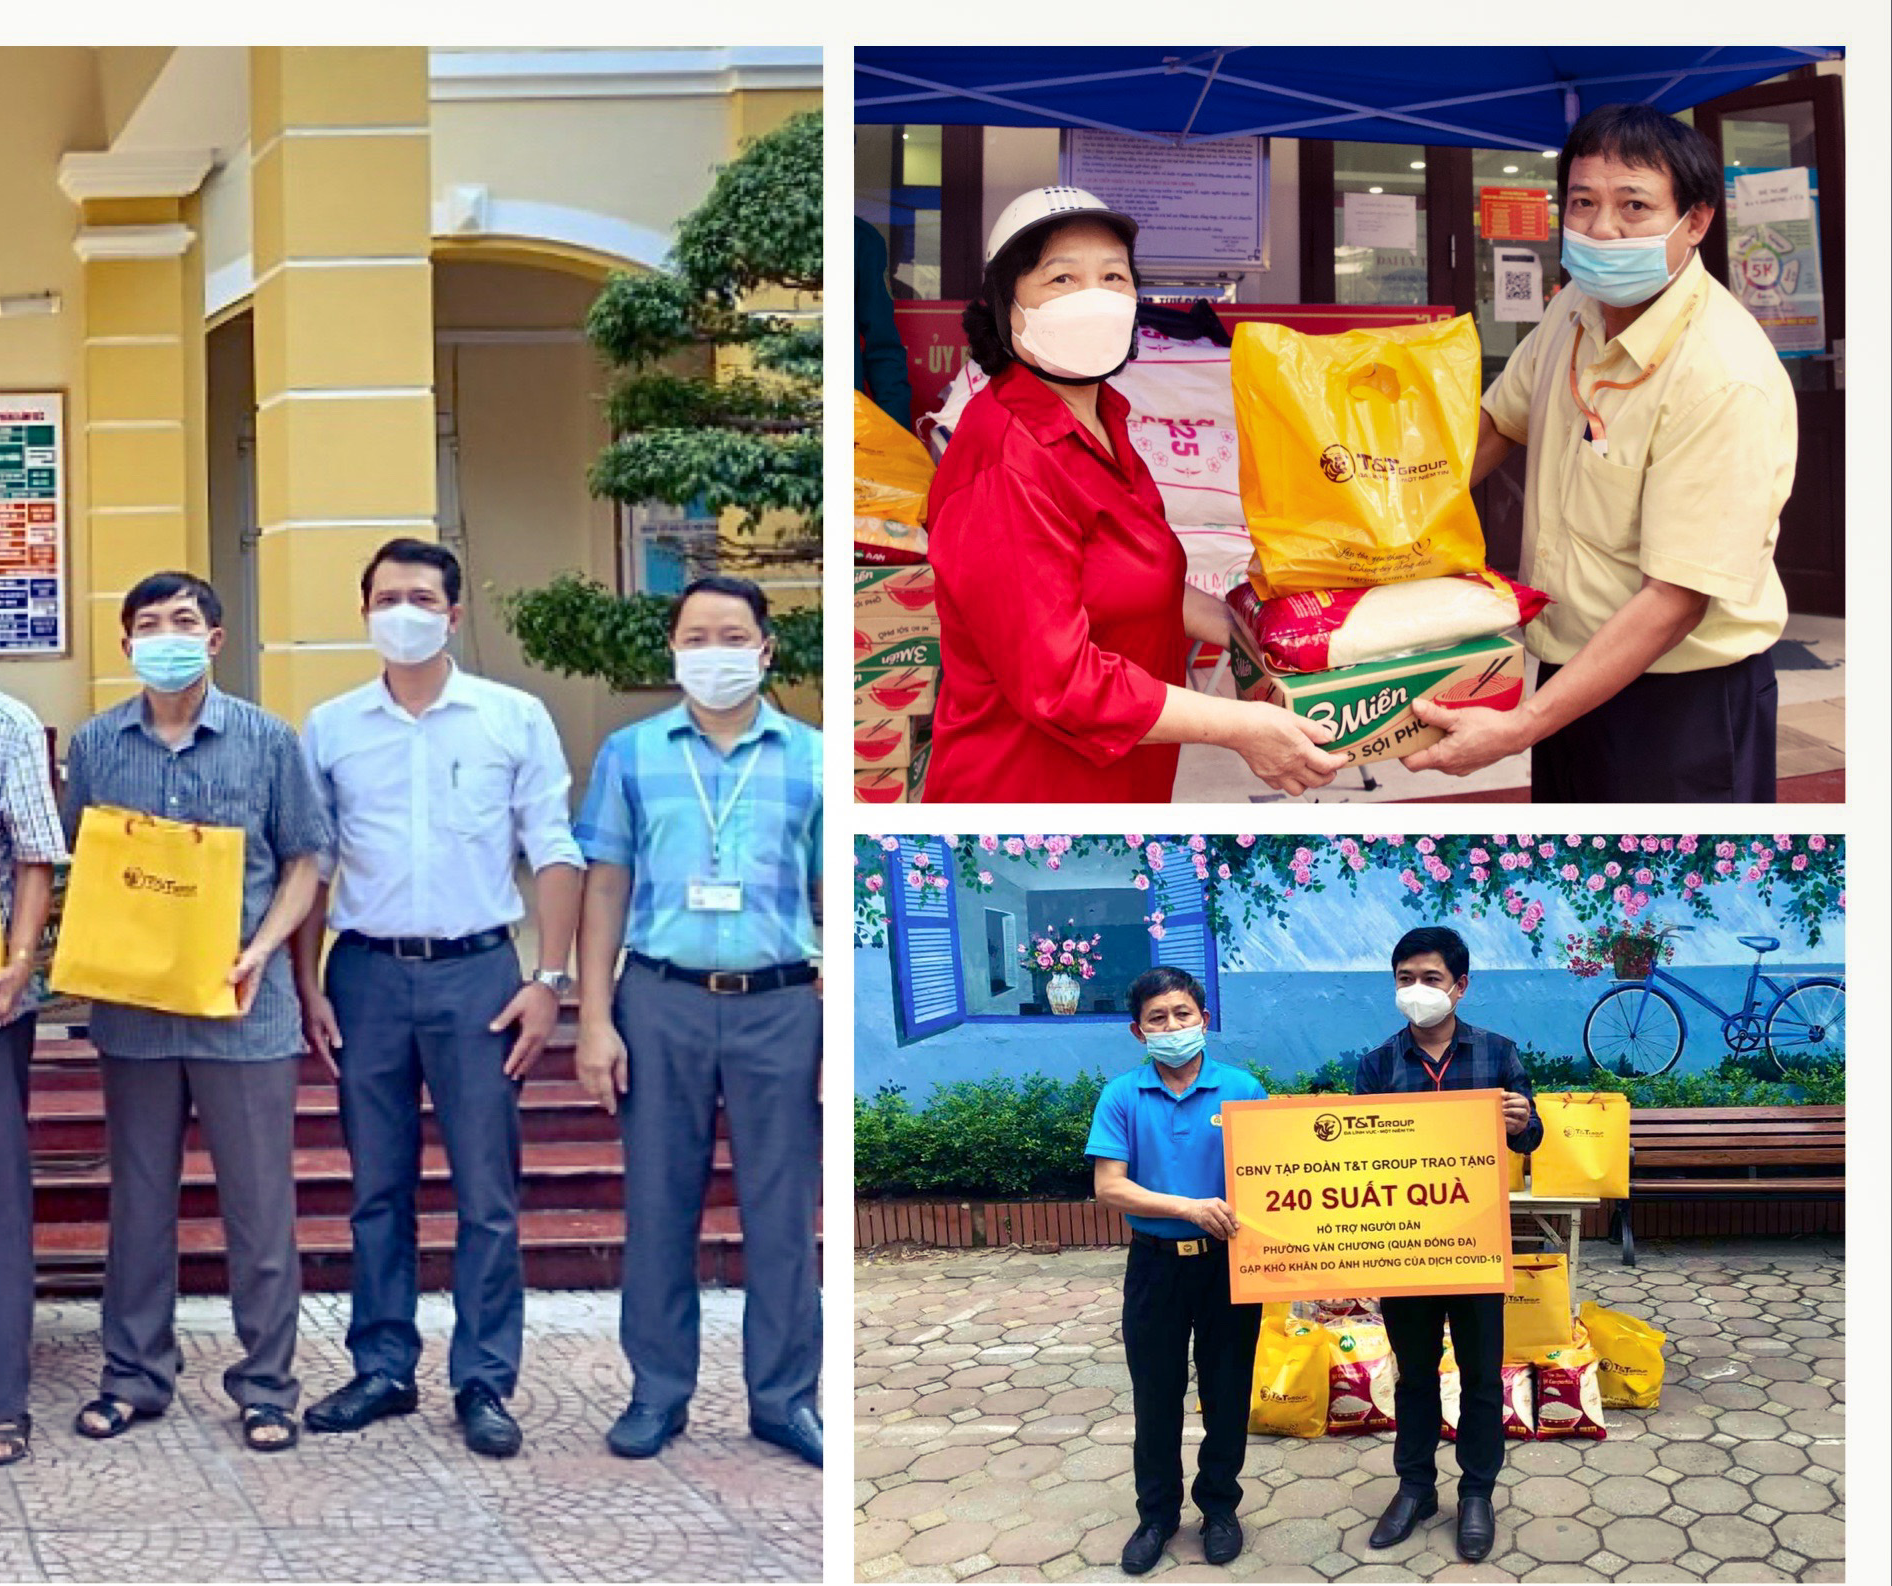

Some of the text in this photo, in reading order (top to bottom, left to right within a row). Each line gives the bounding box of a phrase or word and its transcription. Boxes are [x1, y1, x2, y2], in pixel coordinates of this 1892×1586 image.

[1753, 264, 1773, 277] 5K
[1170, 424, 1200, 457] 25
[1362, 736, 1391, 758] SỢI
[1236, 1155, 1496, 1177] CBNV TẬP ĐOÀN T&T GROUP TRAO TẶNG
[1265, 1177, 1470, 1212] 240 SUẤT QUÀ
[1335, 1224, 1358, 1235] TRỢ
[1399, 1220, 1421, 1231] DÂN
[1338, 1240, 1385, 1251] CHƯƠNG
[1458, 1237, 1476, 1248] ĐA)
[1321, 1260, 1336, 1270] DO
[1428, 1256, 1453, 1267] DỊCH
[1455, 1255, 1502, 1265] COVID-19
